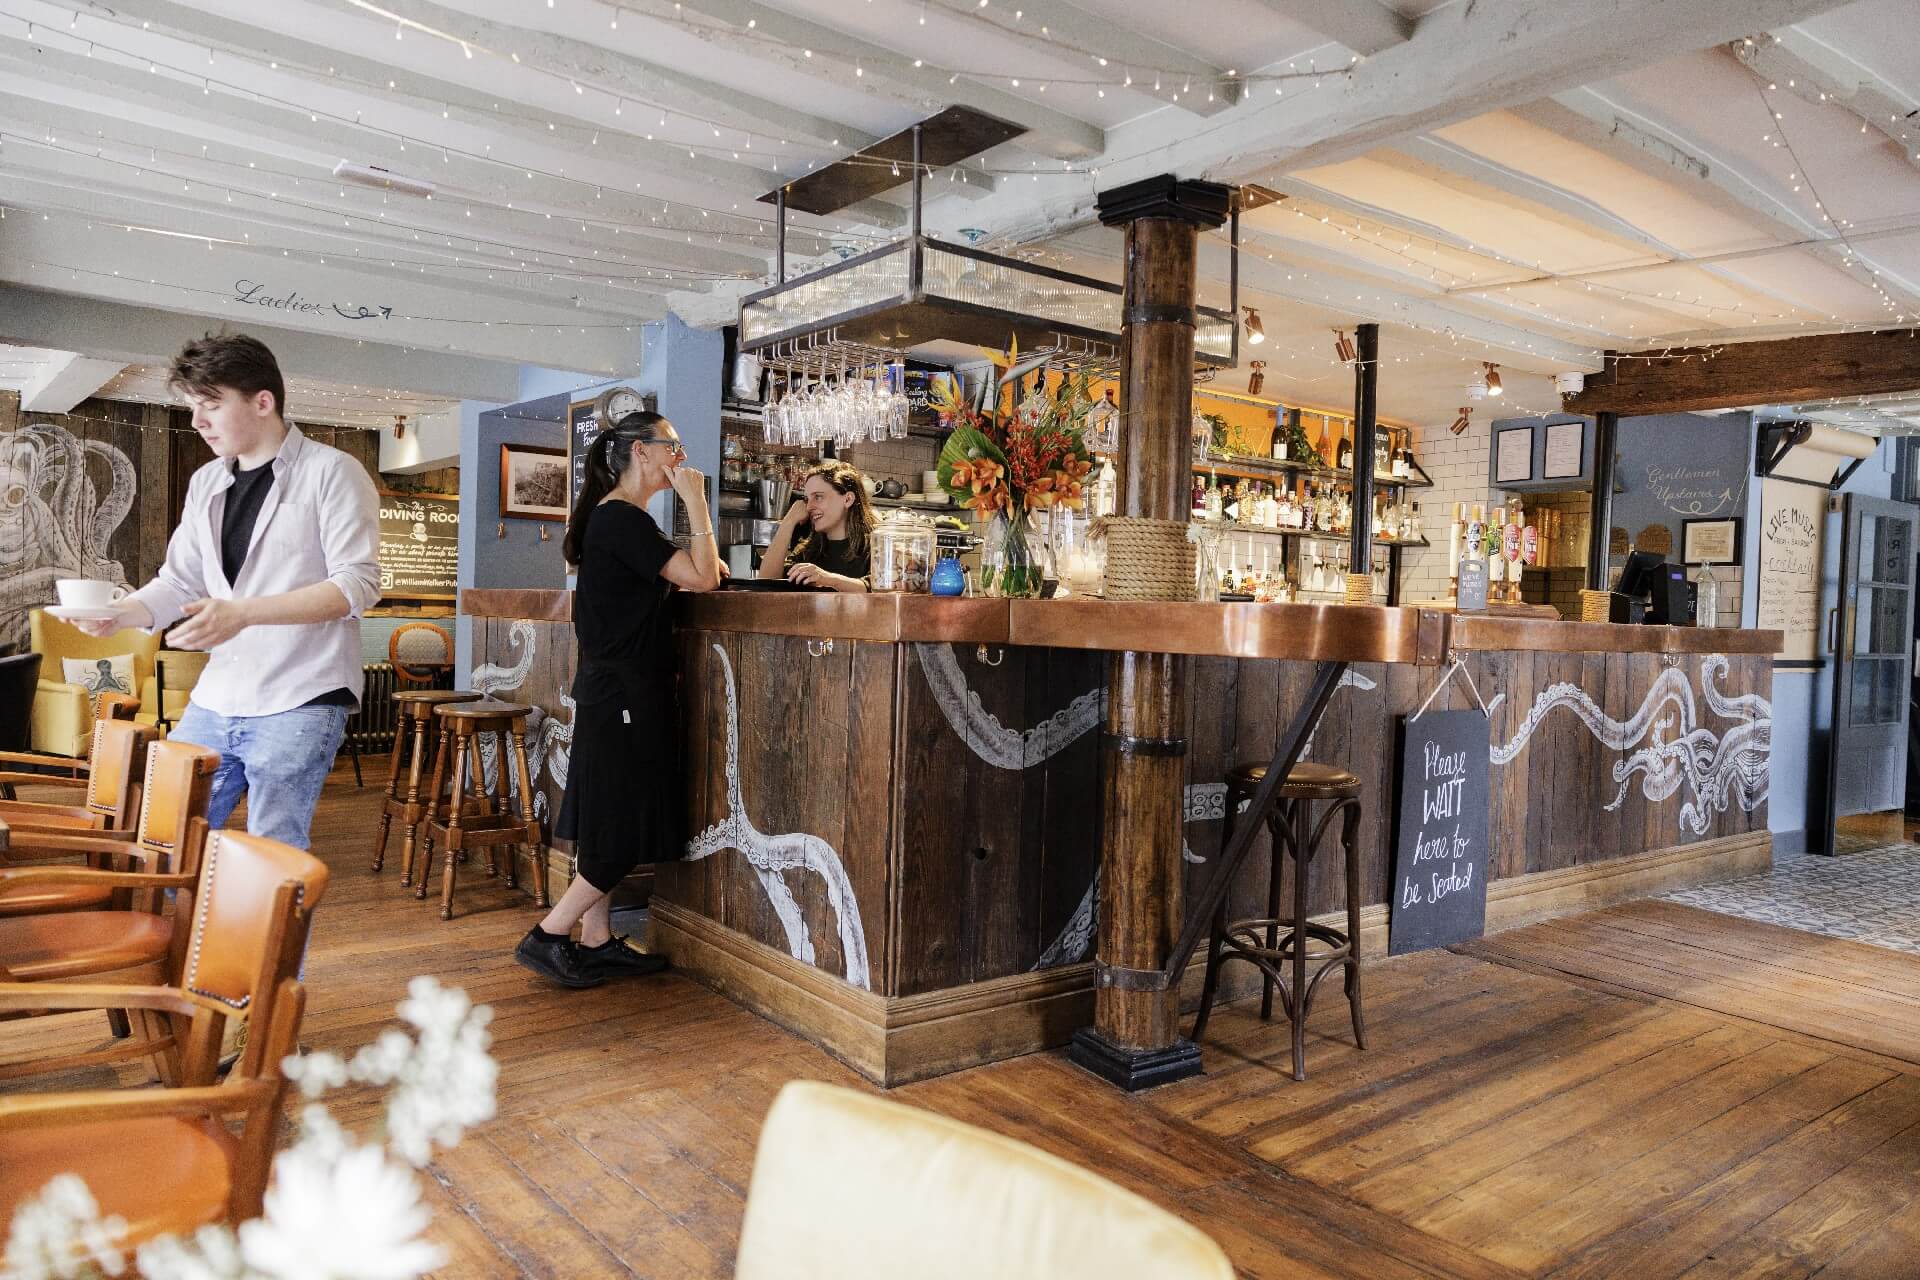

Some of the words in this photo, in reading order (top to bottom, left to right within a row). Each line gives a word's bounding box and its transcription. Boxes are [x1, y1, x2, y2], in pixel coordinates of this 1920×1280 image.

[234, 279, 324, 316] Ladies
[1646, 463, 1720, 489] Gentlemen
[380, 508, 425, 521] DIVING
[430, 512, 460, 523] ROO
[411, 501, 425, 511] The
[1766, 508, 1788, 540] LIVE
[1791, 507, 1817, 544] MUSIC
[1424, 740, 1466, 781] Please
[1413, 831, 1449, 866] here
[1453, 823, 1470, 859] to
[1402, 876, 1422, 909] be
